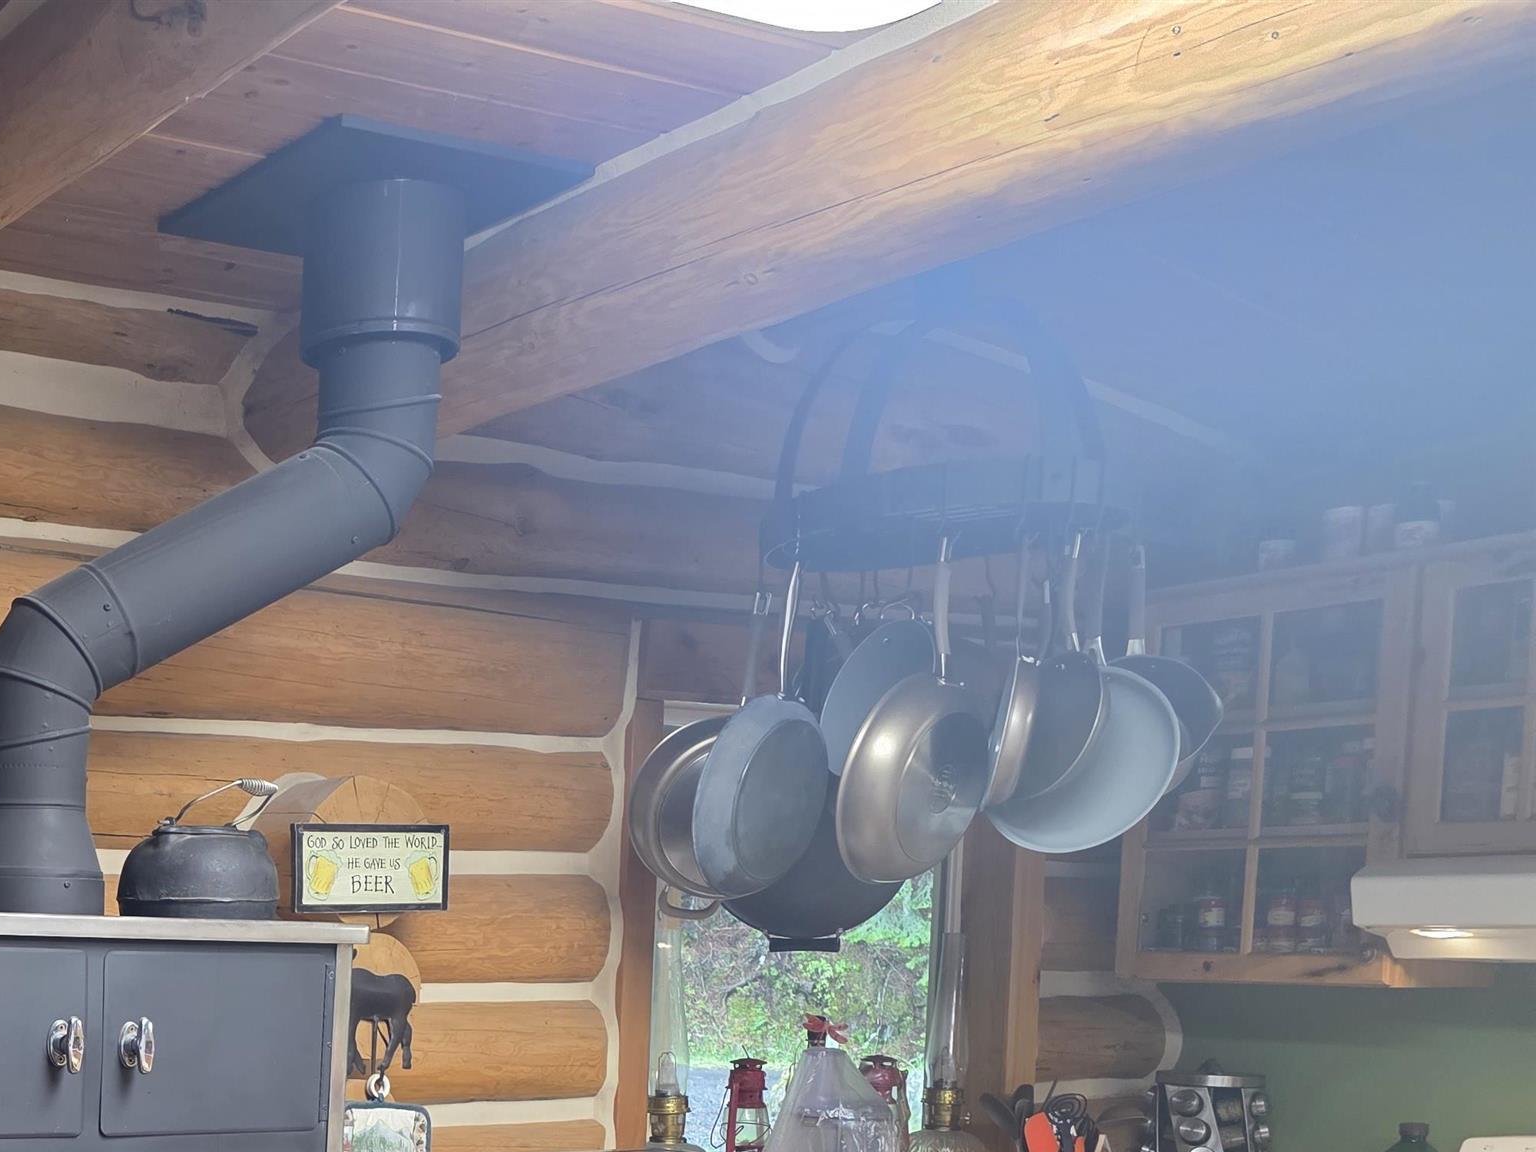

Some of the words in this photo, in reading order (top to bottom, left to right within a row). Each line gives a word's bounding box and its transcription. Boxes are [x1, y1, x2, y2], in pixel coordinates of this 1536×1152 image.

[307, 834, 327, 849] GOD
[331, 836, 345, 850] SO
[349, 835, 378, 849] LOVED
[383, 835, 400, 849] THE
[347, 857, 361, 869] HE
[363, 857, 387, 870] GAVE
[389, 857, 401, 870] US
[351, 874, 395, 894] BEER
